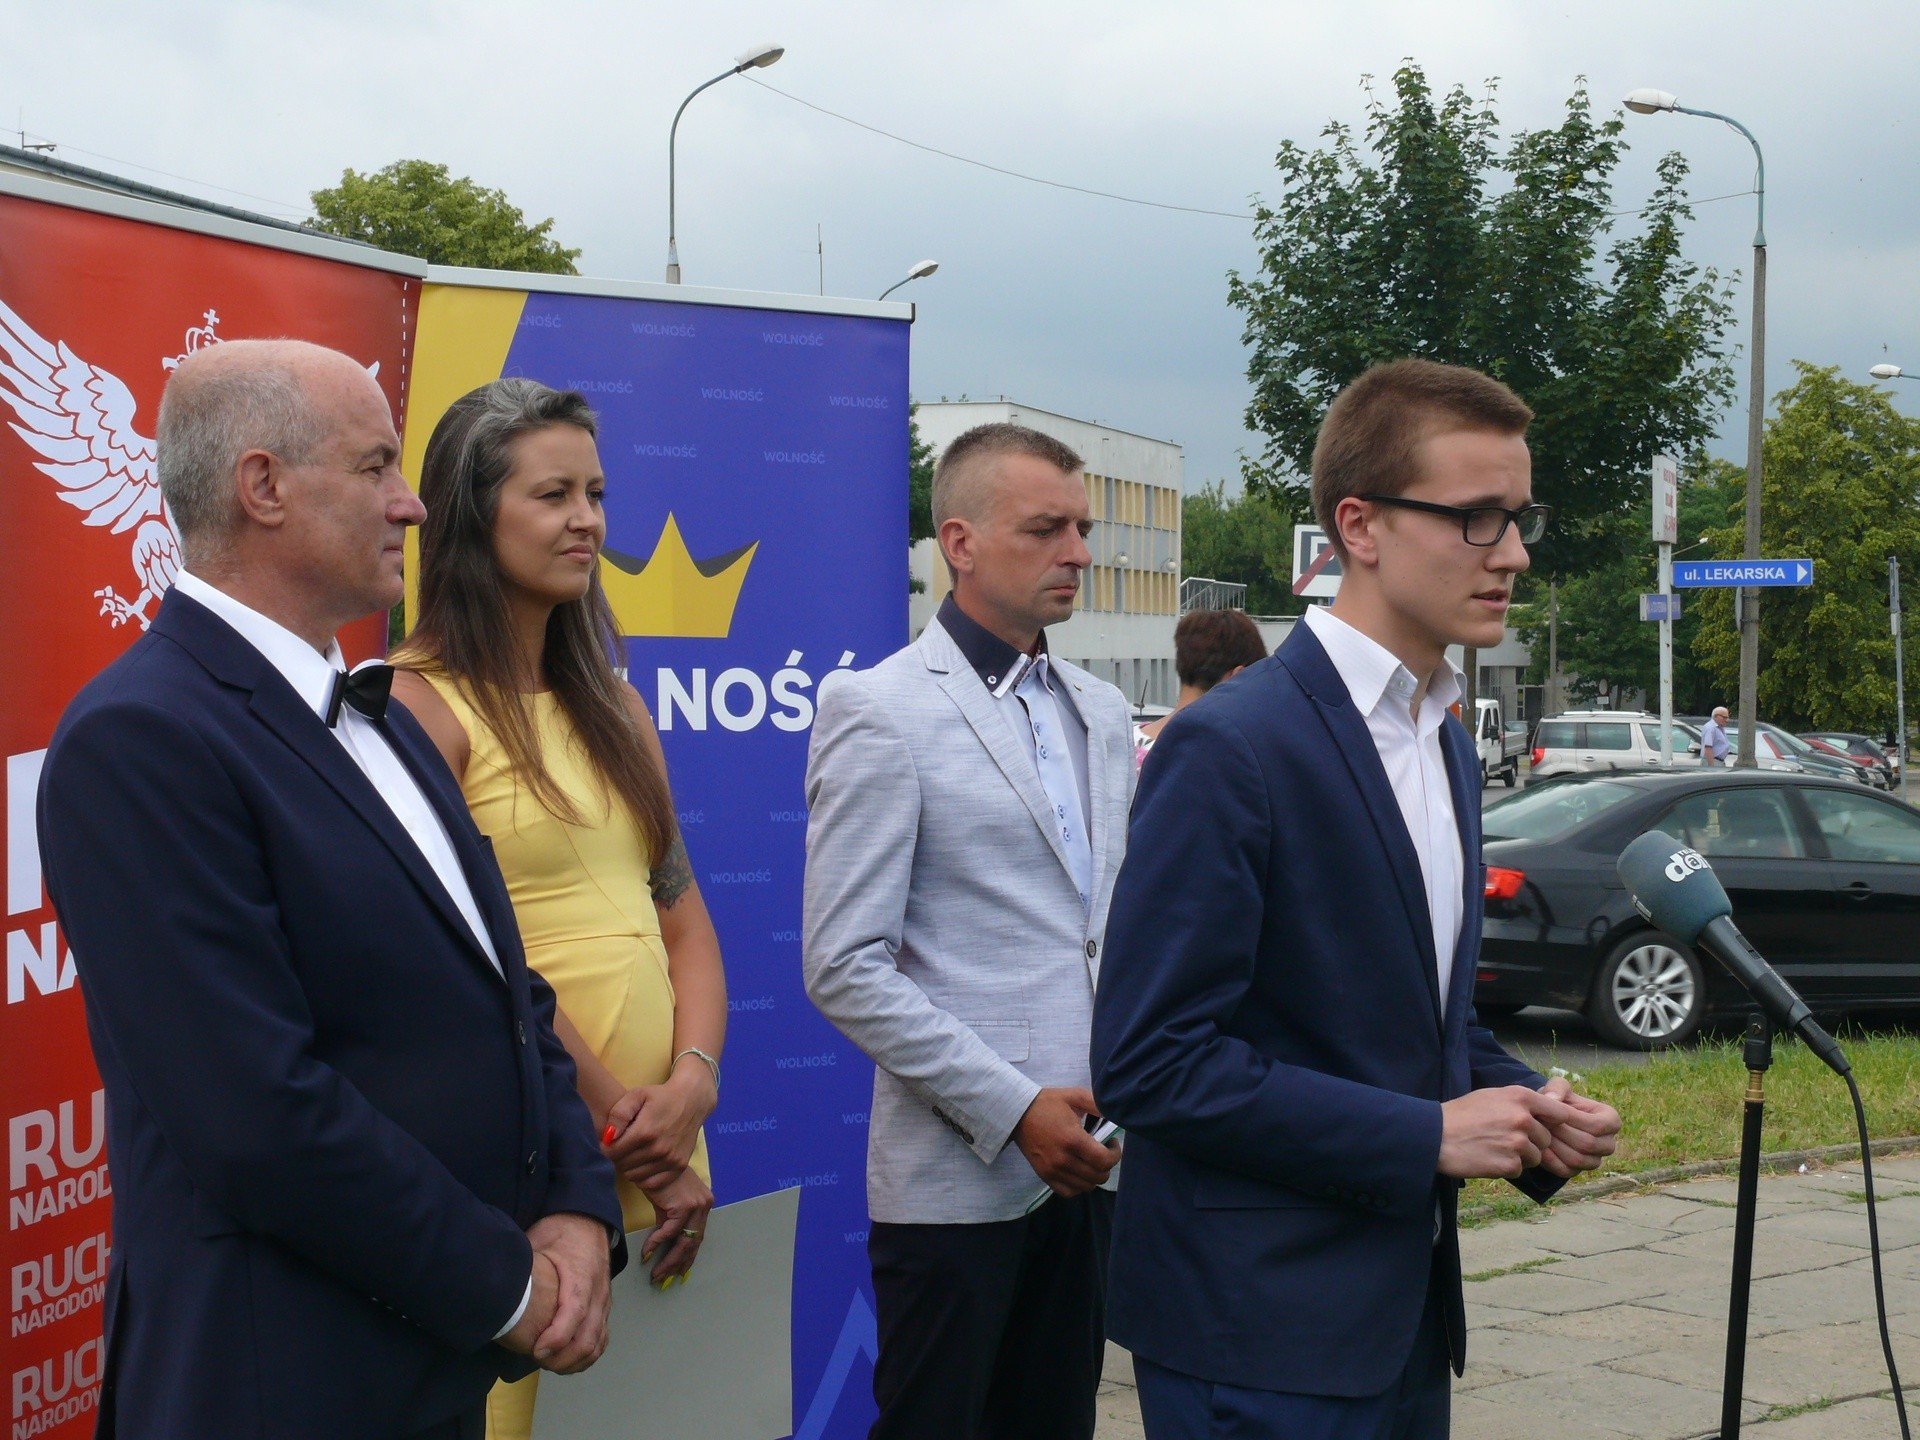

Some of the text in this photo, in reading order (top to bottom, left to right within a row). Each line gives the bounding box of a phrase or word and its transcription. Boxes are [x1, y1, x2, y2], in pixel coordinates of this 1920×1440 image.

[631, 322, 696, 339] WOLNOŚĆ
[762, 332, 825, 347] WOLNOŚĆ
[567, 378, 889, 410] WOLNOŚĆ WOLNOŚĆ WOLNOŚĆ
[633, 443, 826, 465] WOLNOŚĆ WOLNOŚĆ
[1684, 567, 1786, 580] ul. LEKARSKA
[769, 811, 808, 823] WOLN
[710, 868, 772, 884] WOLNOŚĆ
[772, 930, 803, 942] WOL
[775, 1052, 837, 1069] WOLNOŚĆ
[717, 1116, 778, 1134] WOLNOŚĆ
[778, 1171, 839, 1189] WOLNOŚĆ
[11, 1232, 111, 1313] RUCH
